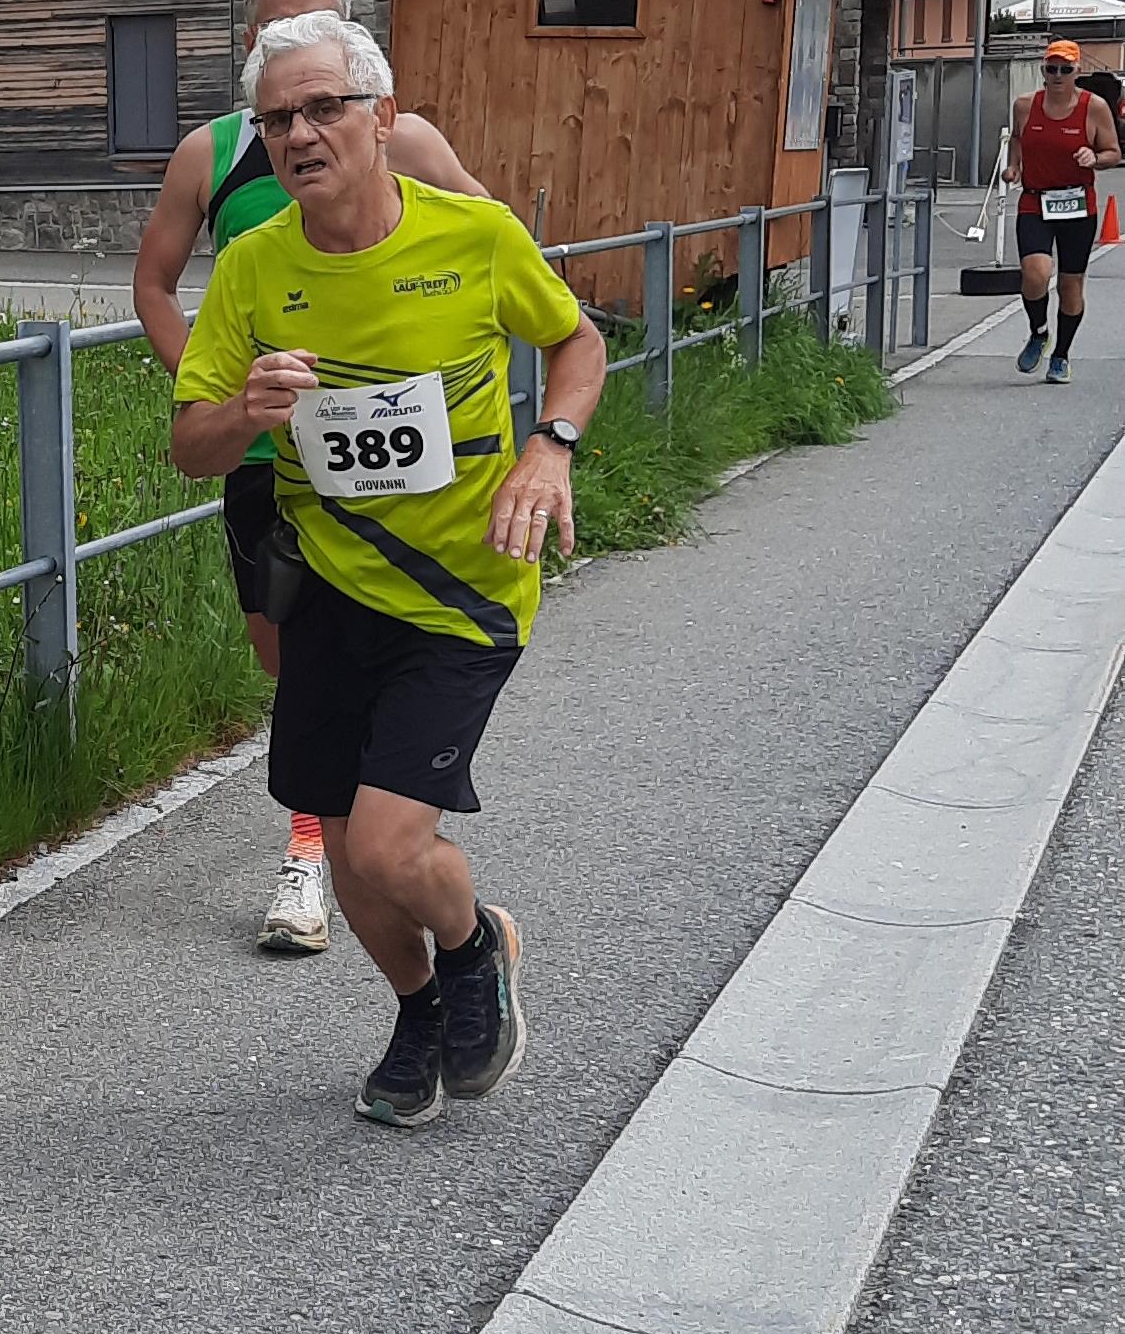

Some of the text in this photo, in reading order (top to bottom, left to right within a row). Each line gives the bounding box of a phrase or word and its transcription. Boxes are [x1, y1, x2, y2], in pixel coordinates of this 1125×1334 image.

[1049, 199, 1079, 212] 2059
[369, 404, 423, 420] MIZUNO
[322, 425, 424, 472] 389
[354, 478, 406, 492] GIOVANNI
